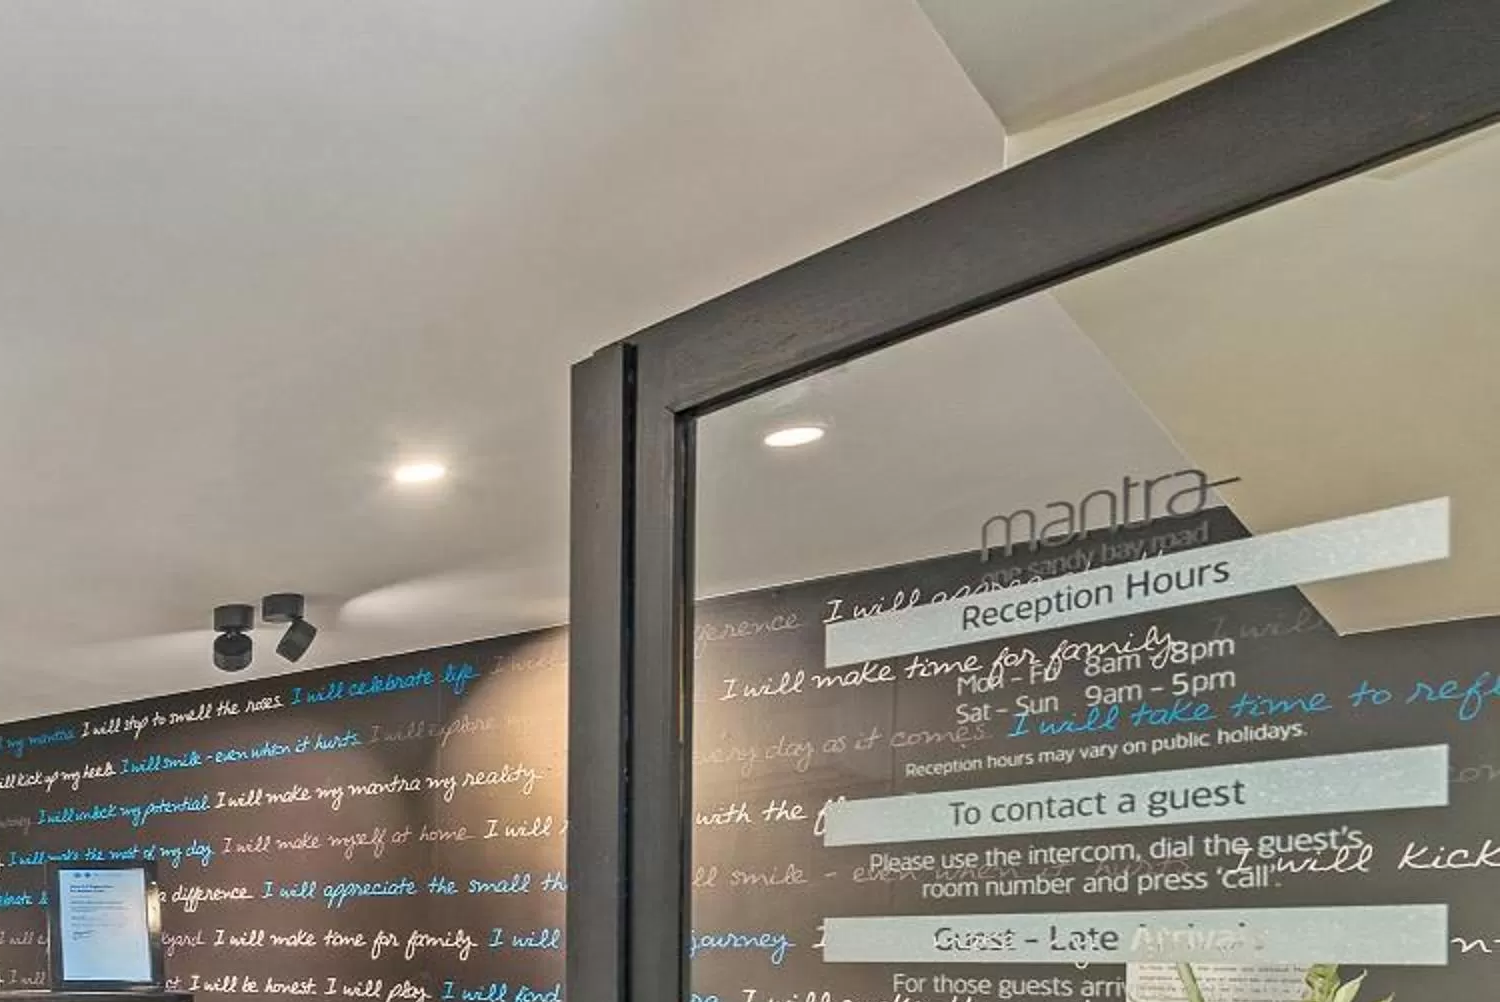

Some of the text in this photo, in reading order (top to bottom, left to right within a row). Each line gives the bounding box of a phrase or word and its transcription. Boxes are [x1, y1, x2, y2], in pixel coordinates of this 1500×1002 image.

[980, 468, 1242, 562] mantra
[1026, 548, 1095, 577] sandy
[1101, 537, 1146, 562] bay
[1151, 521, 1209, 551] road
[823, 599, 843, 624] I
[853, 588, 921, 619] will
[962, 581, 1113, 631] Reception
[1127, 560, 1231, 599] Hours
[718, 679, 738, 701] I
[743, 670, 804, 698] will
[811, 662, 896, 688] make
[904, 654, 982, 680] time
[989, 647, 1041, 688] for
[1084, 651, 1141, 678] 8am
[1170, 637, 1236, 666] 8pm
[169, 669, 432, 724] smell the celebrate
[956, 670, 1236, 724] Sat Sun 9am 5pm
[765, 736, 814, 774] day
[823, 738, 848, 753] as
[854, 727, 883, 750] it
[1008, 712, 1030, 738] I
[1039, 704, 1119, 735] will
[1128, 700, 1217, 727] take
[1229, 692, 1333, 718] time
[1348, 680, 1393, 707] to
[215, 738, 291, 763] even when
[904, 722, 1308, 779] Reception hours may vary on public holidays.
[267, 775, 456, 810] make my mantra my
[950, 779, 1246, 827] To contact a guest
[696, 799, 808, 826] with the
[277, 828, 386, 860] make myself
[869, 824, 1363, 874] Please use the intercom, dial the guest's
[1235, 839, 1500, 873] I will kick
[323, 878, 417, 908] appreciate
[428, 876, 459, 893] the
[468, 872, 531, 893] small
[730, 863, 808, 887] smile
[922, 880, 979, 900] room
[984, 873, 1075, 898] number
[1082, 869, 1129, 894] and
[1137, 867, 1208, 897] press
[269, 929, 399, 959] make time for
[934, 925, 1017, 952] Guest
[1050, 924, 1120, 952] Late
[242, 975, 258, 993] be
[893, 973, 1073, 999] For those guests
